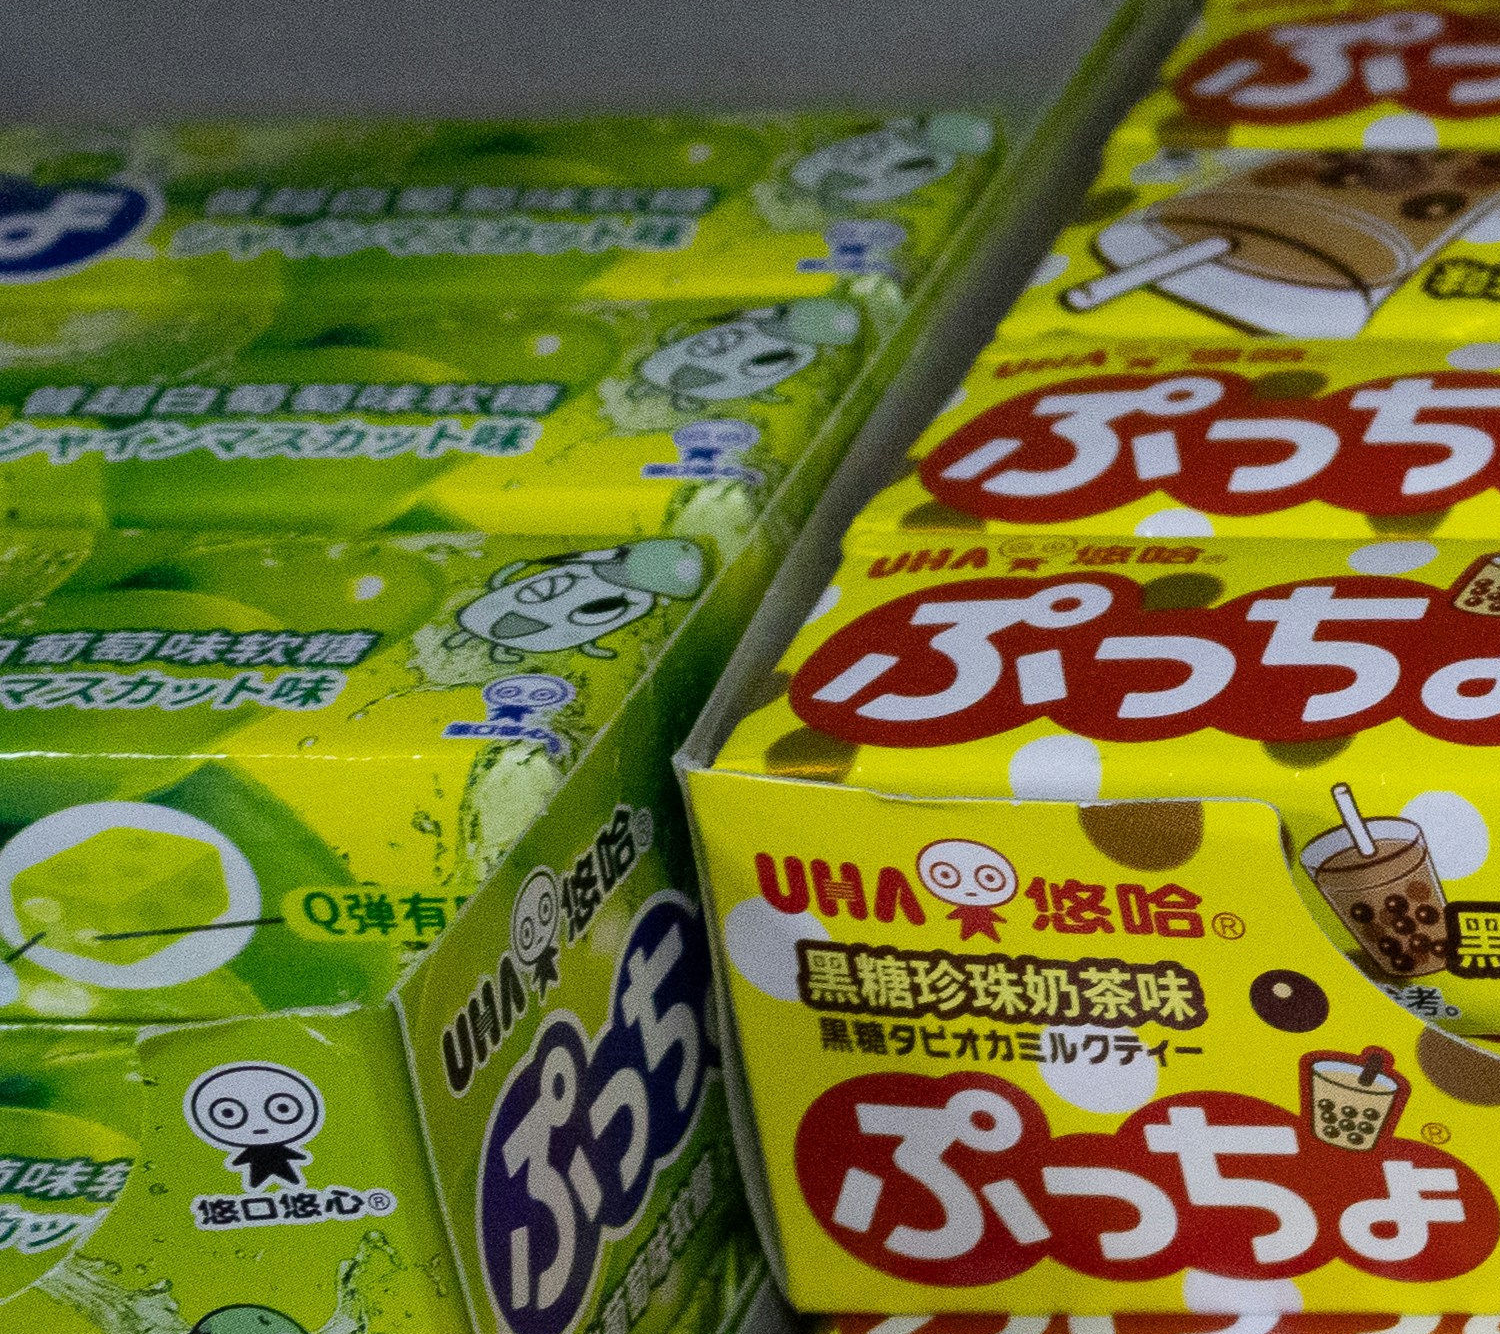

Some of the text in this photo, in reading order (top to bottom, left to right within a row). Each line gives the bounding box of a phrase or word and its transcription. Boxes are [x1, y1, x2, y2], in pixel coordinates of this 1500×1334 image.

[869, 546, 1201, 577] UHA 悠哈
[755, 853, 1203, 938] UHA 悠哈
[804, 948, 1198, 1024] 黑糖珍珠奶茶味
[441, 958, 526, 1092] UHA
[820, 1019, 1203, 1066] 黑糖タピオカミルクティー
[198, 1193, 362, 1225] 悠口悠心
[832, 1089, 1465, 1264] ぷっちょ
